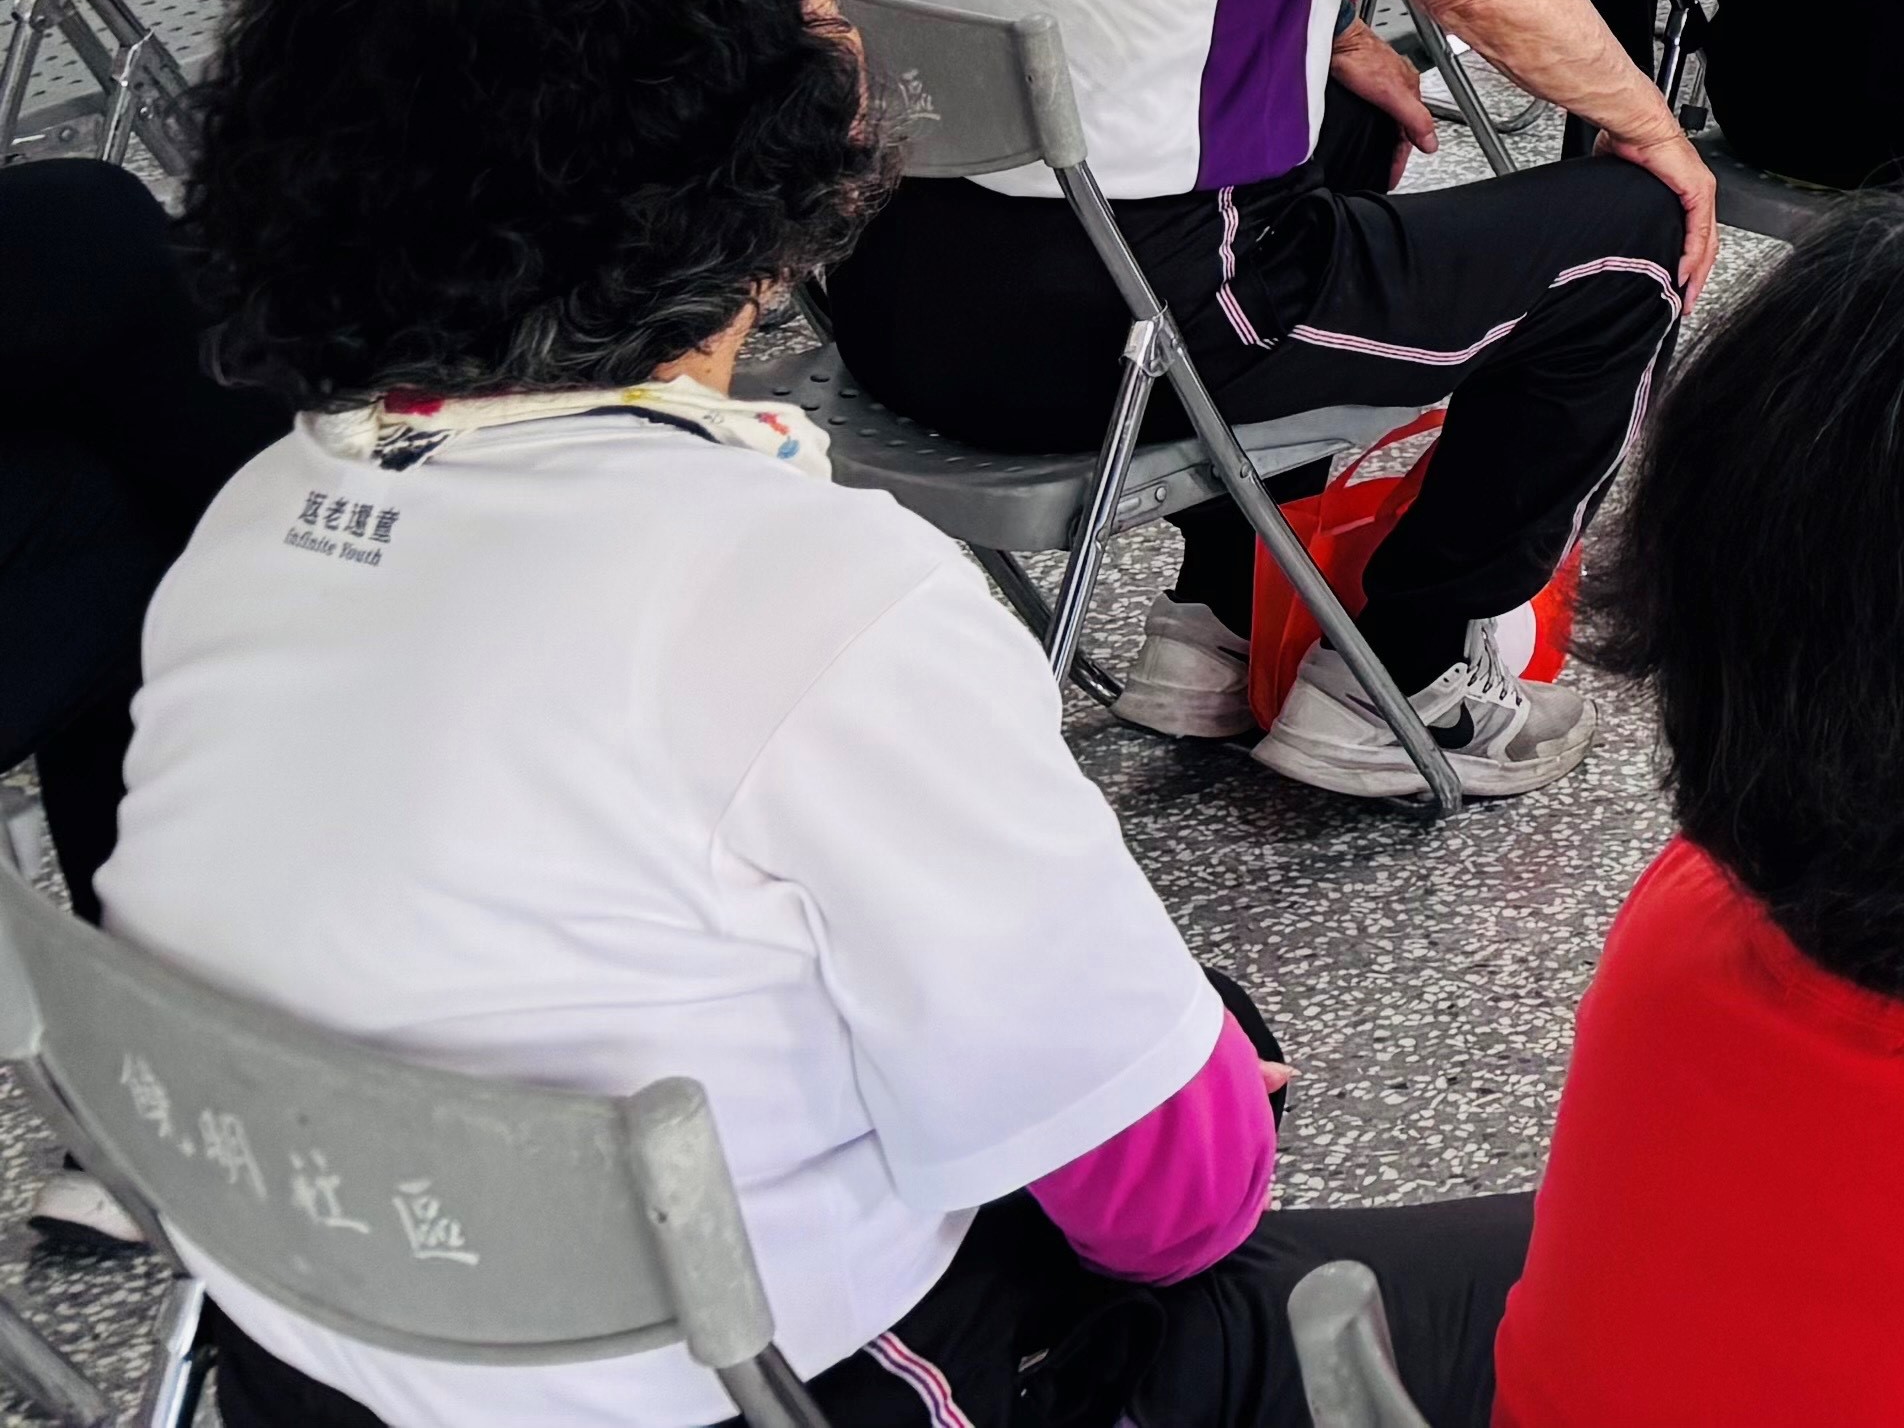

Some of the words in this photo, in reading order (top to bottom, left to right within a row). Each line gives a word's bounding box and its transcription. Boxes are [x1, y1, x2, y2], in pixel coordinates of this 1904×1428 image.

[299, 489, 401, 545] 返老還童
[284, 526, 337, 558] Infinite
[339, 540, 384, 569] Youth
